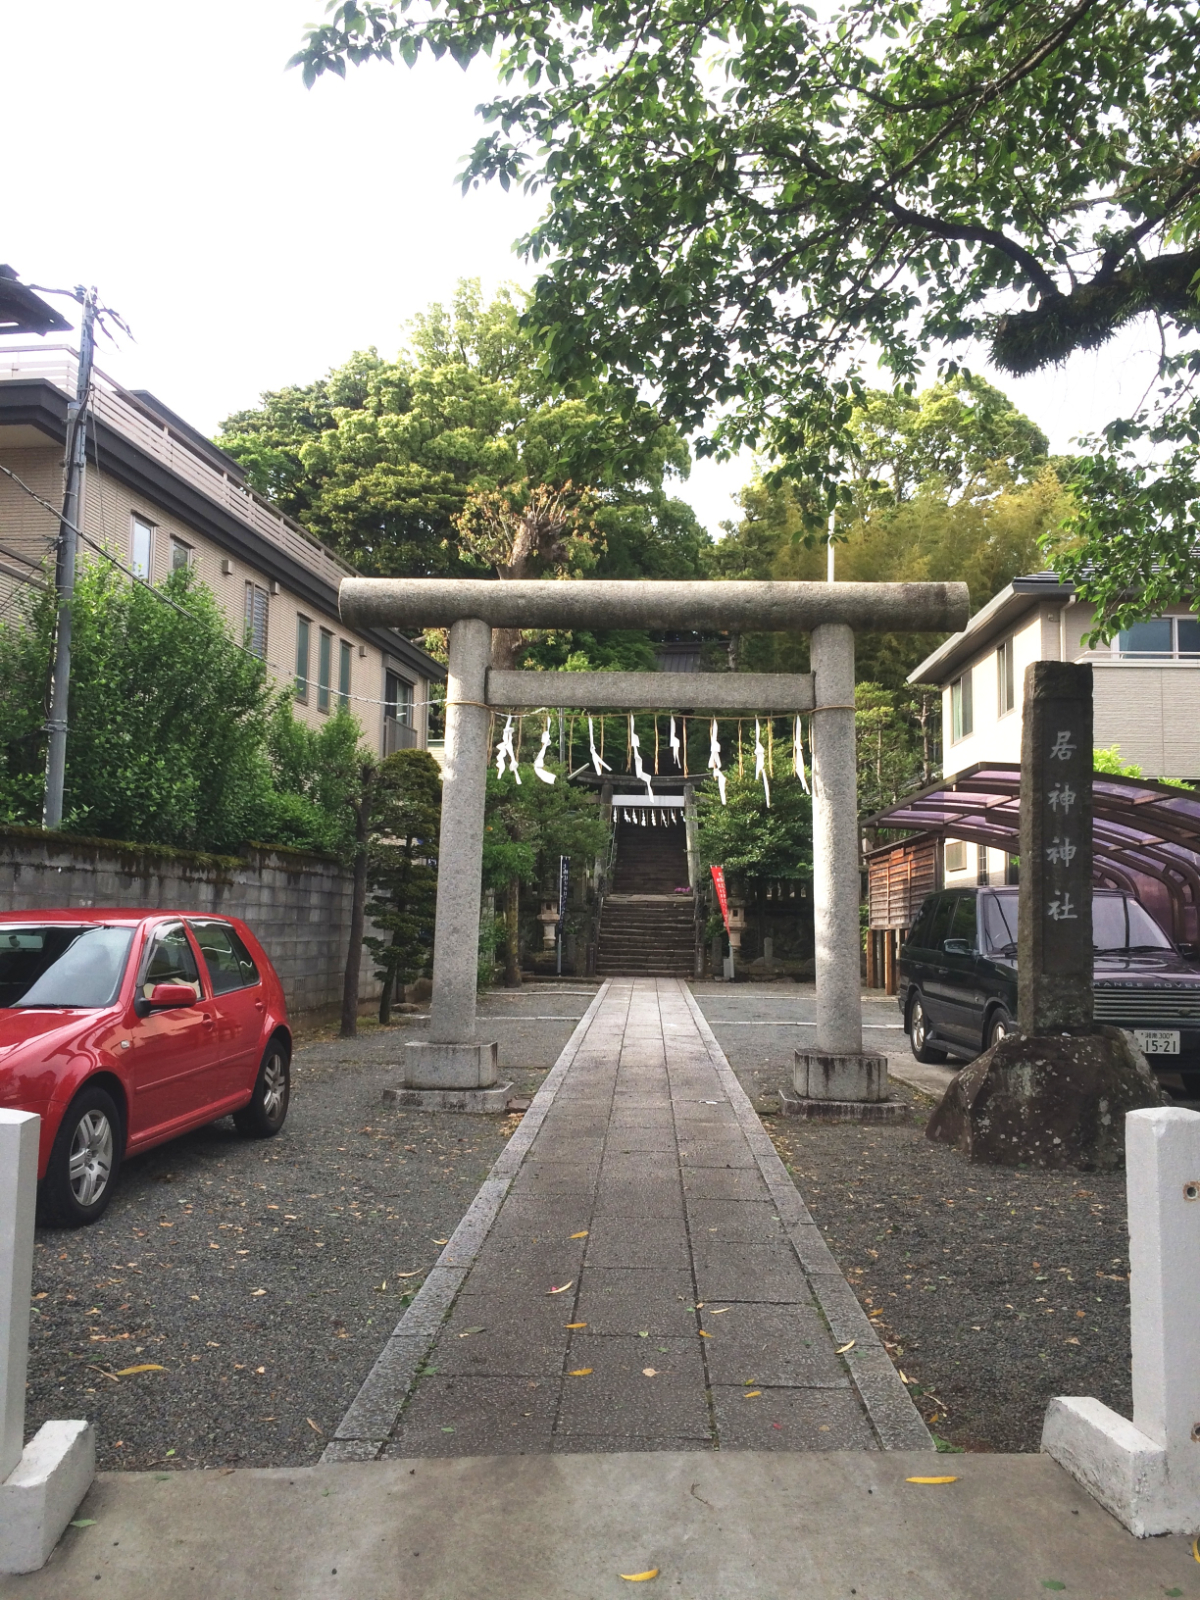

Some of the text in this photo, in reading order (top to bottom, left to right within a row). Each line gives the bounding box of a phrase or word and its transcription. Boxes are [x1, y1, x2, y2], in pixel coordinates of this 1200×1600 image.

[1046, 730, 1078, 921] 居神神社
[1146, 1040, 1176, 1052] 15-21
